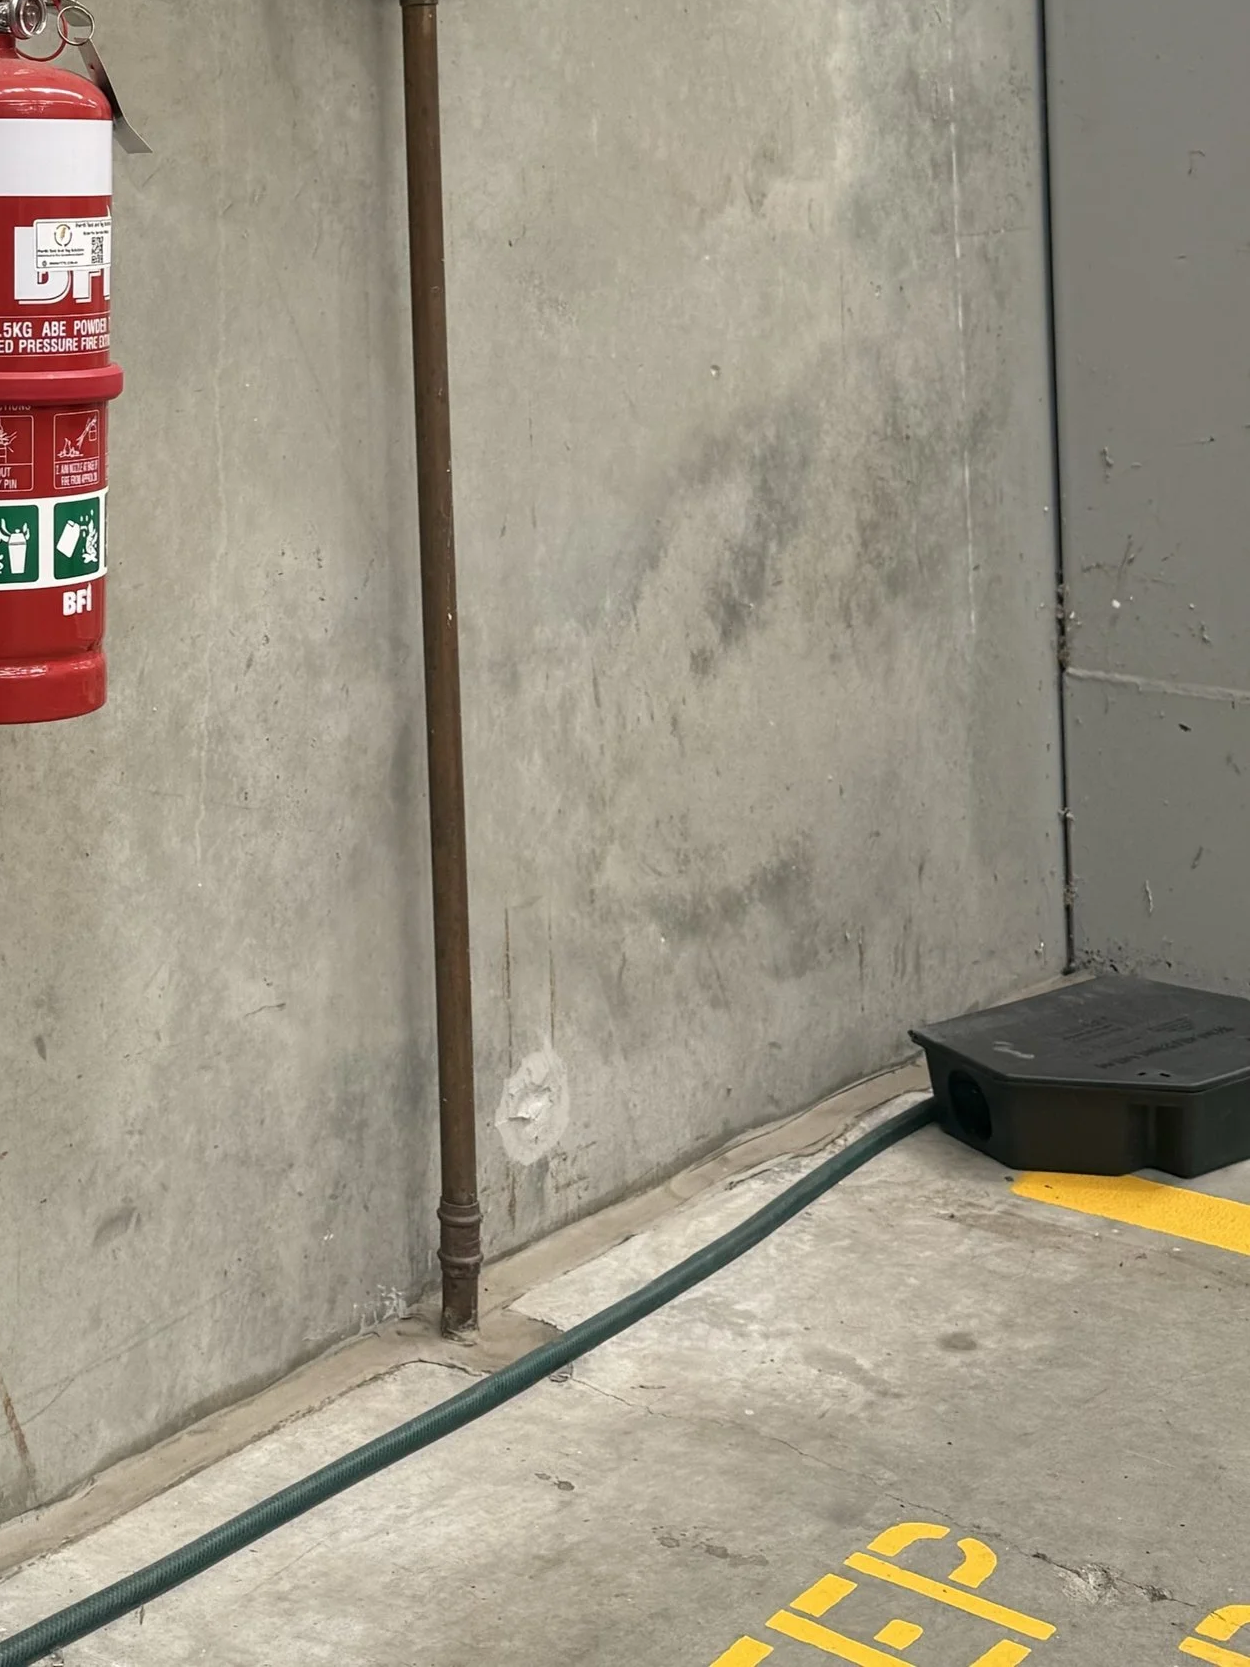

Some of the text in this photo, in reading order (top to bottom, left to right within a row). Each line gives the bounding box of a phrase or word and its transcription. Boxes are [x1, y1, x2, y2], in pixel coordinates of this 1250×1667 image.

[42, 321, 66, 337] ABE
[73, 318, 107, 335] POWDER
[19, 338, 78, 353] PRESSURE
[81, 336, 98, 351] FIRE
[4, 479, 17, 489] PIN
